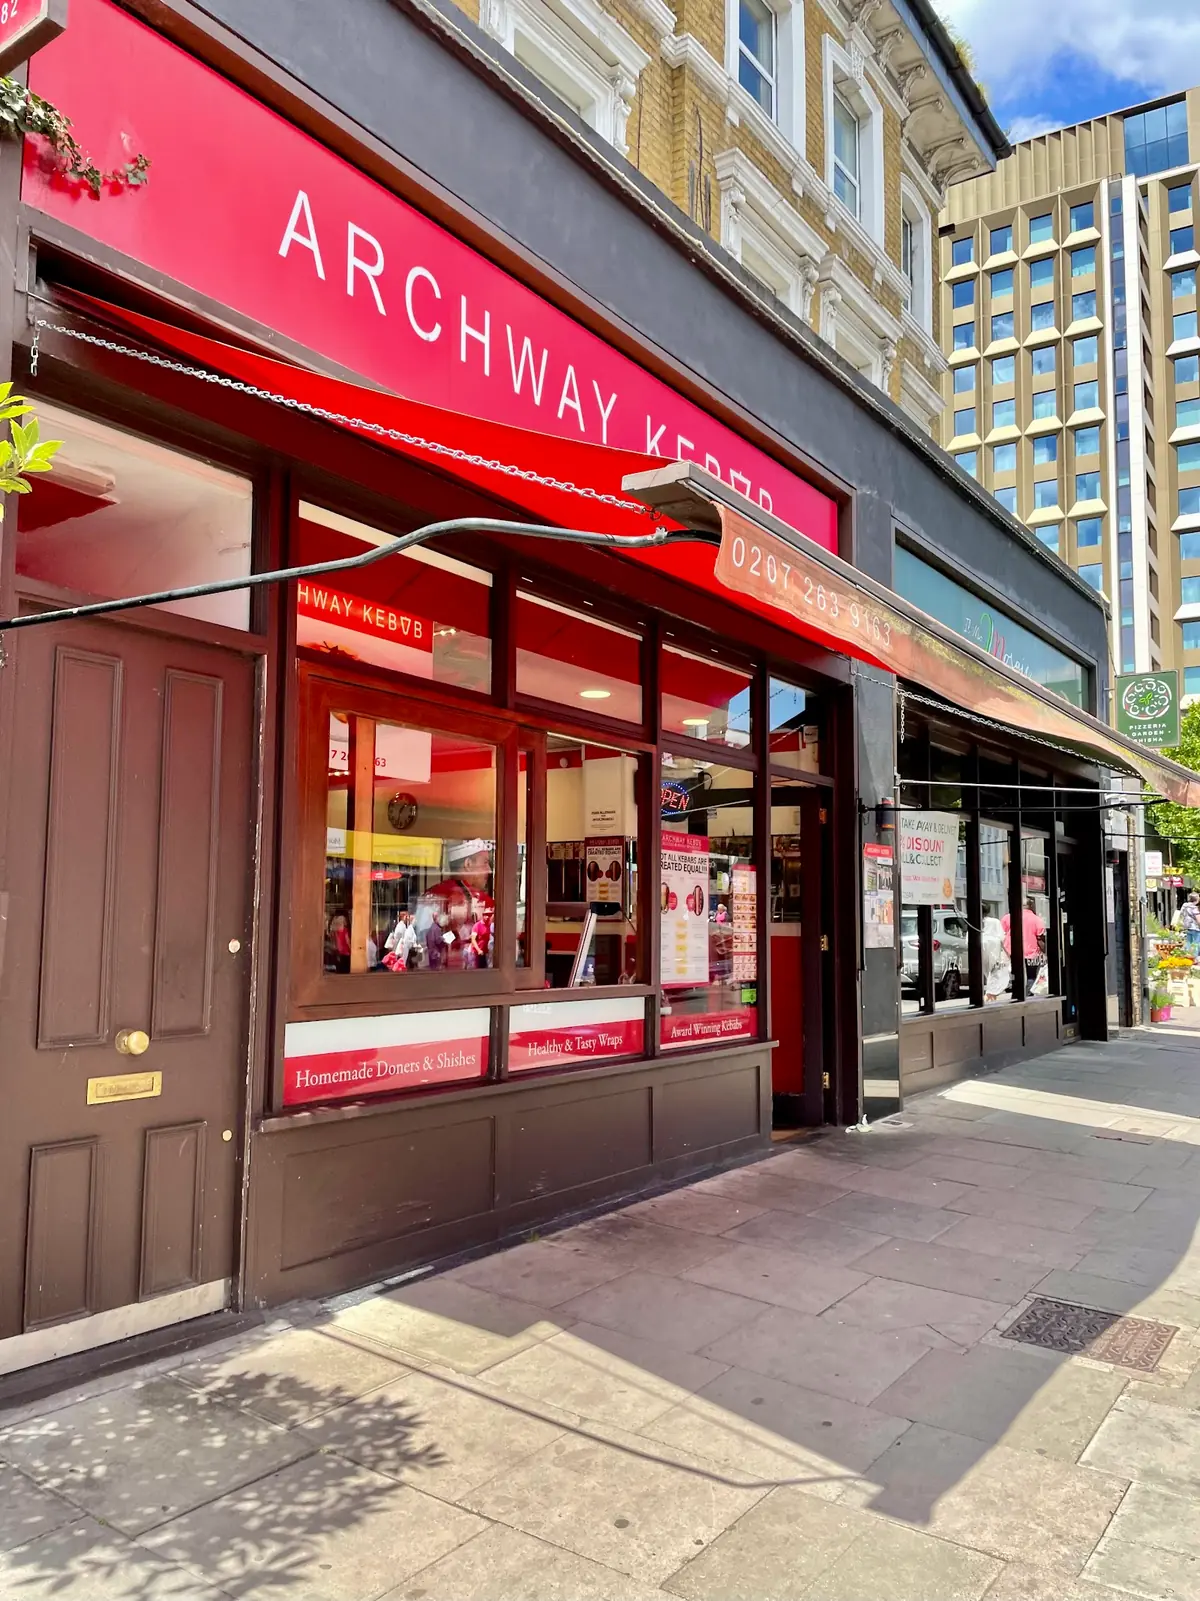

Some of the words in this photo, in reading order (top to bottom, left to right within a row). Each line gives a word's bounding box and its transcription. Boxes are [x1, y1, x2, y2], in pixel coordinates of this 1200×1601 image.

[278, 189, 617, 444] ARCHWAY
[297, 582, 353, 617] HWAY
[732, 537, 790, 589] 0207
[804, 570, 839, 617] 263
[850, 603, 891, 646] 9163
[1128, 723, 1167, 731] PIZZERIA
[660, 861, 682, 872] REATED
[670, 1023, 693, 1039] Award
[693, 1022, 721, 1036] Winning
[721, 1018, 743, 1032] Kebabs
[528, 1039, 562, 1057] Healthy
[564, 1039, 573, 1052] &
[575, 1036, 597, 1053] Tasty
[598, 1033, 623, 1050] Wraps
[295, 1062, 373, 1088] Homemade
[376, 1060, 420, 1078] Doners
[422, 1056, 435, 1072] &
[436, 1050, 476, 1069] Shishes
